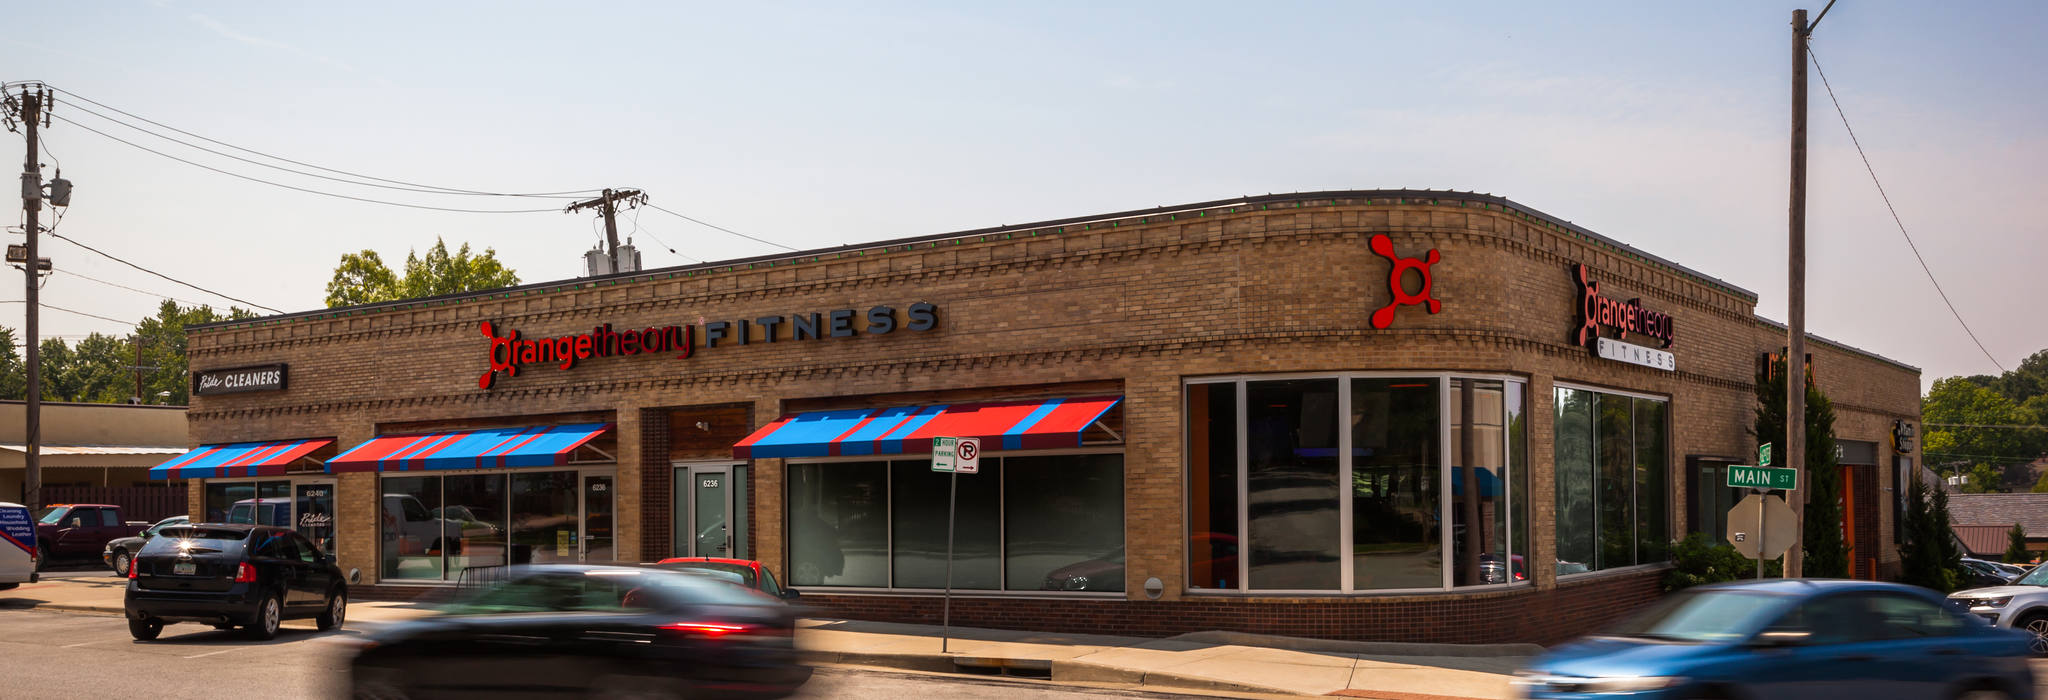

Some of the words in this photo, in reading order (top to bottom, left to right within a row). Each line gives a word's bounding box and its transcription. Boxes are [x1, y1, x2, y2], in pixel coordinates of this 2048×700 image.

[705, 301, 936, 348] FITNESS
[1599, 341, 1673, 368] FITNESS
[199, 374, 222, 392] Pride
[225, 371, 280, 388] CLEANERS
[1734, 469, 1771, 485] MAIN
[1780, 475, 1789, 483] ST
[300, 512, 331, 526] Pride
